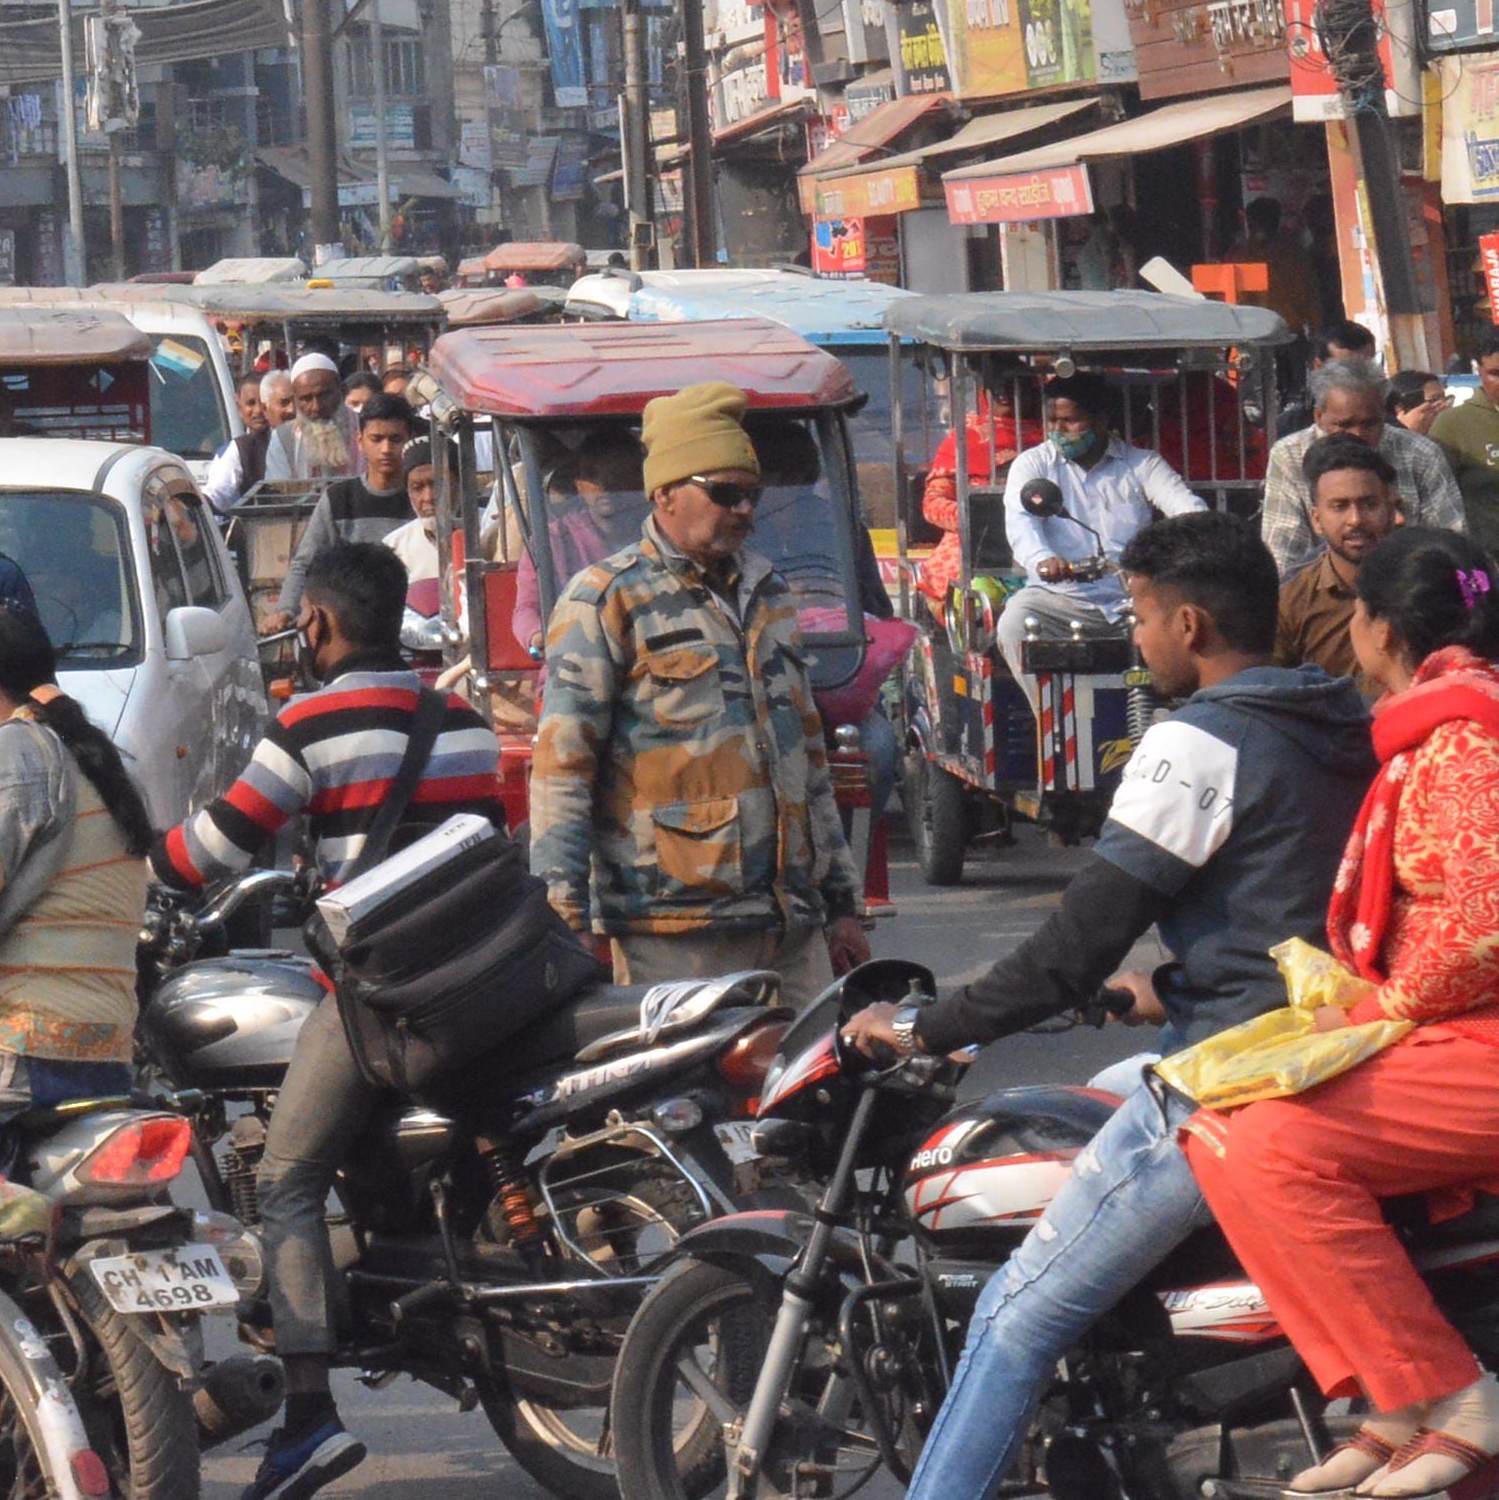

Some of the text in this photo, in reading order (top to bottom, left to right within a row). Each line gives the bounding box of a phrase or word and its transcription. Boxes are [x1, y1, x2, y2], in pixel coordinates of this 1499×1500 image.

[910, 1145, 953, 1171] Hero
[103, 1257, 221, 1289] CH 1 AM
[938, 1273, 975, 1282] POWER
[944, 1280, 978, 1288] START
[136, 1284, 214, 1309] 4698
